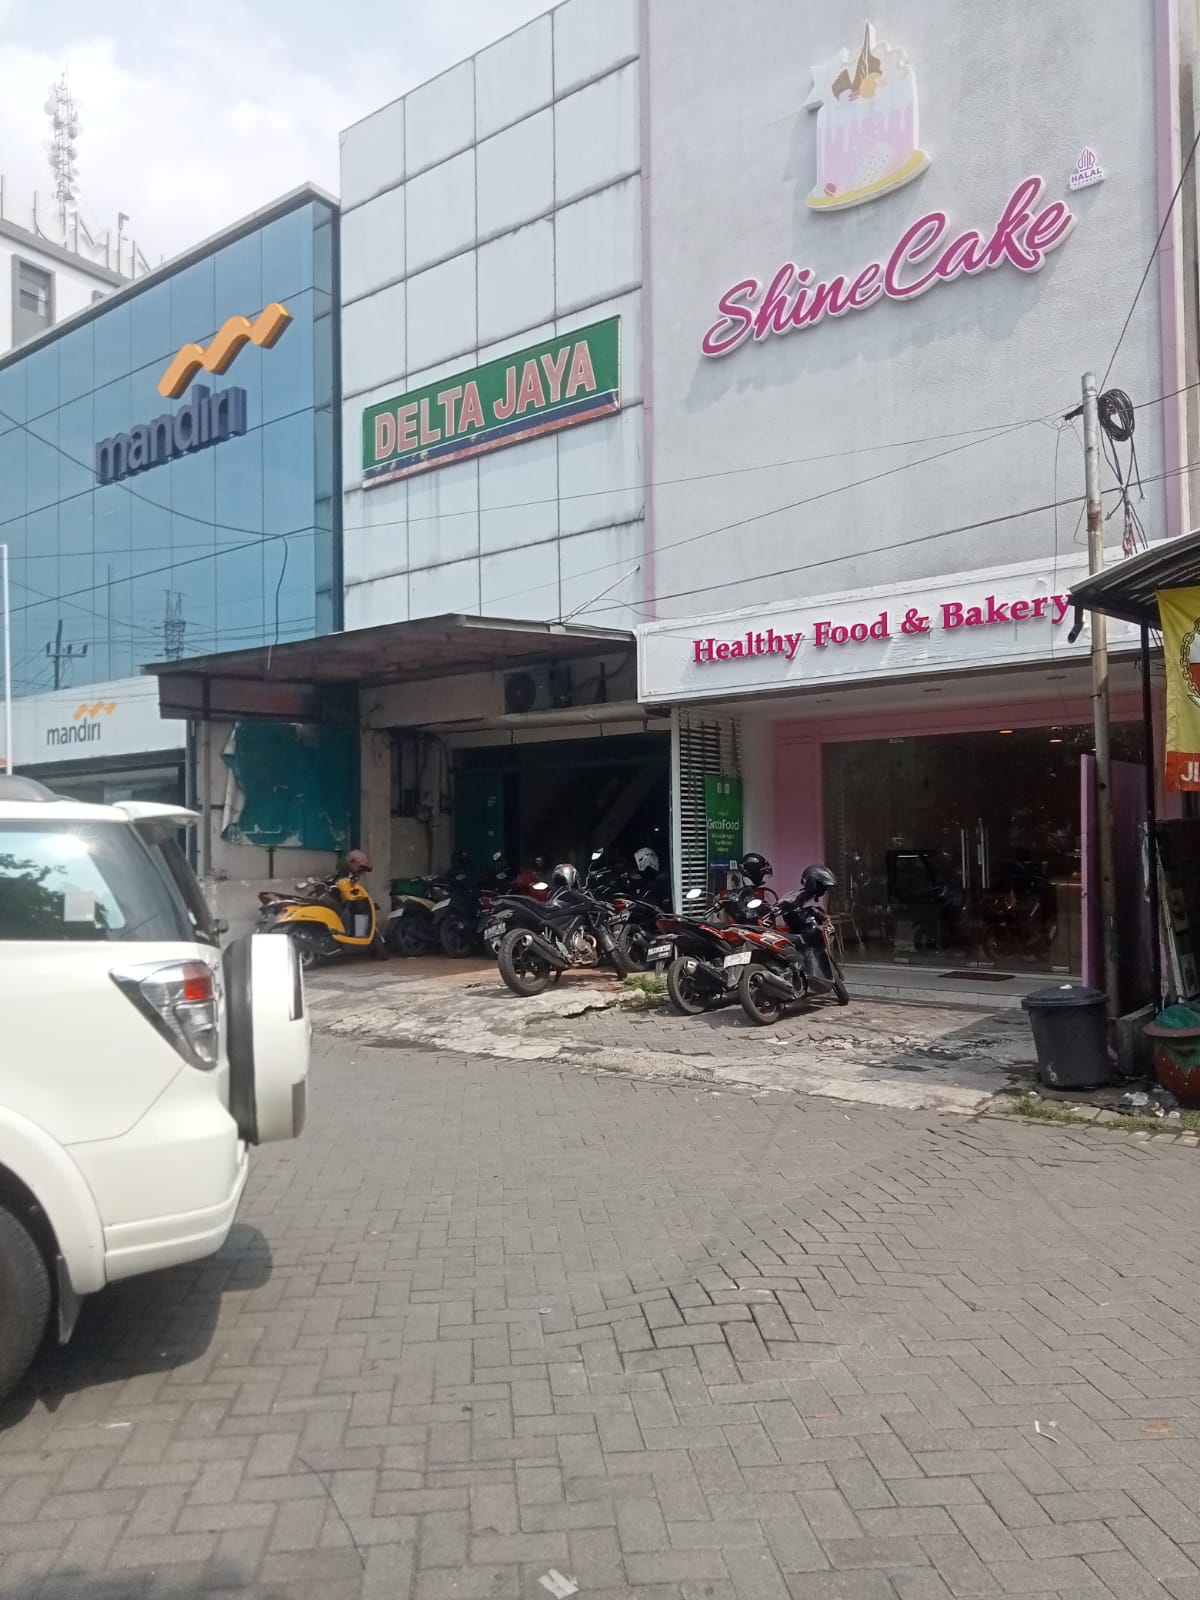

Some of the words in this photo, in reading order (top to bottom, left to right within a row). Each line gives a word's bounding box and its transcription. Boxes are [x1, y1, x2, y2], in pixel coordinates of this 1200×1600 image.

[1071, 167, 1102, 183] HALAL
[95, 384, 247, 485] mandiri
[374, 380, 485, 461] DELTA
[493, 340, 597, 419] JAYA
[692, 629, 803, 663] Healthy
[813, 612, 890, 647] Food
[901, 607, 930, 635] &
[940, 593, 1071, 630] Bakery
[46, 717, 101, 746] mandiri
